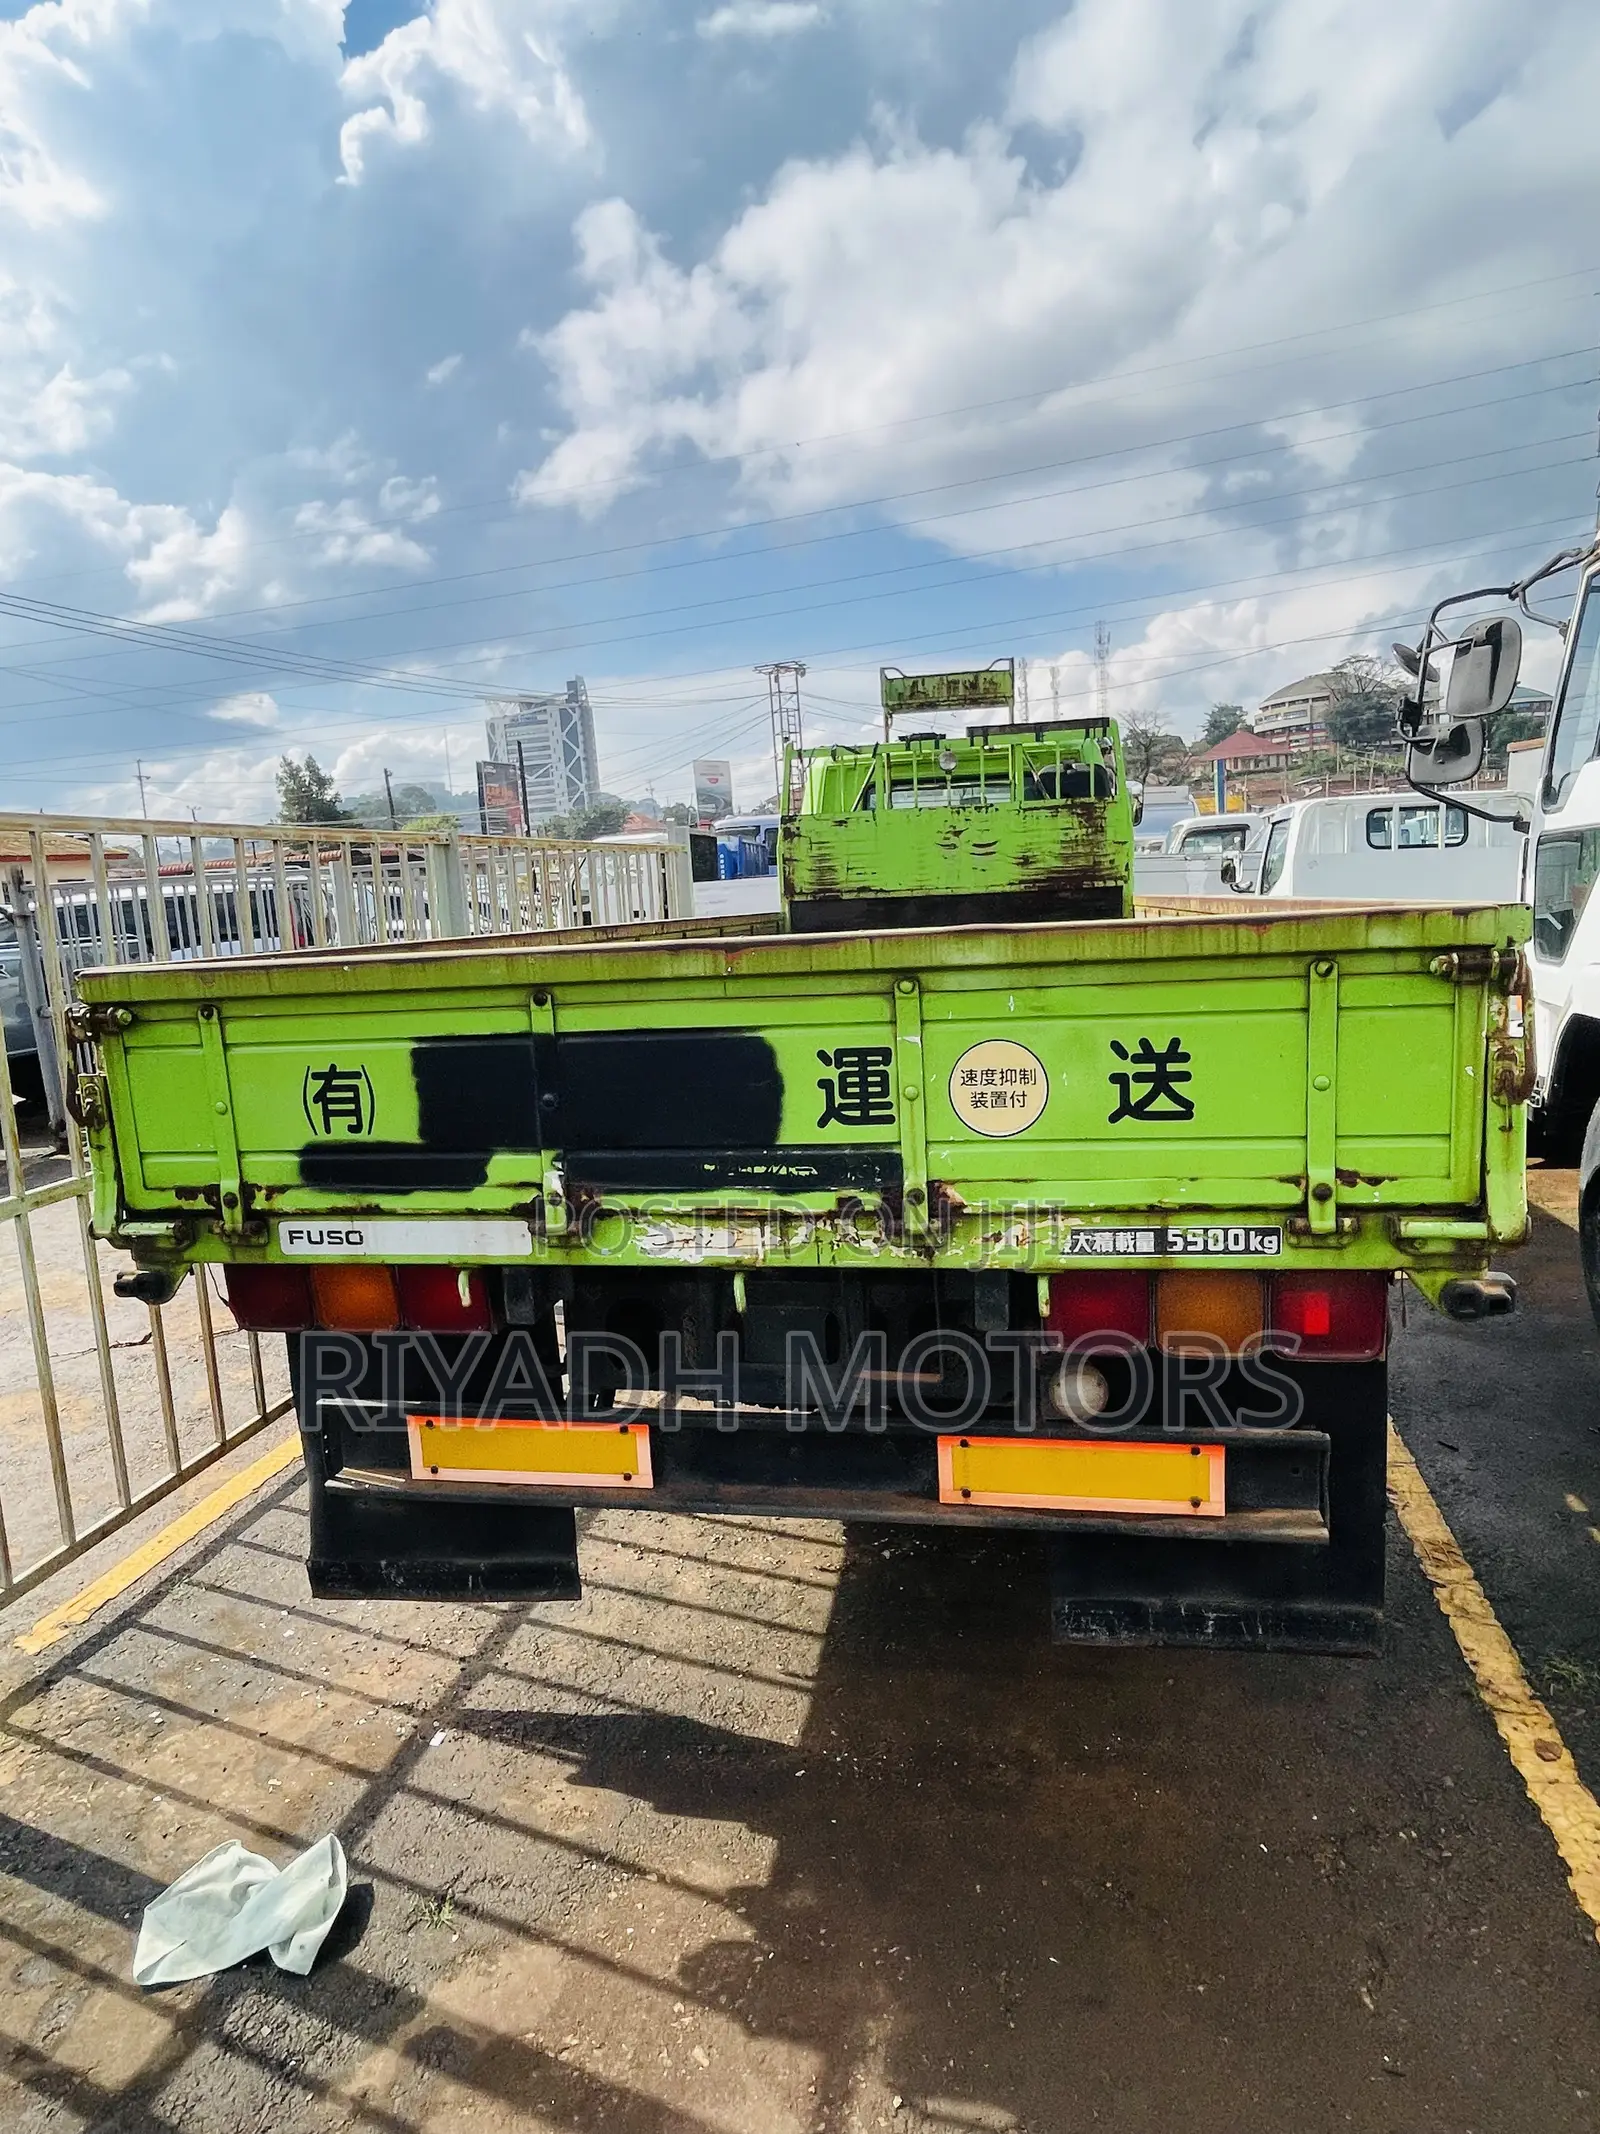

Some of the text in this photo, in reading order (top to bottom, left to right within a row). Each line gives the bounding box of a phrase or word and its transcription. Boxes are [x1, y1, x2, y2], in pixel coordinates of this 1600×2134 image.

[816, 1046, 896, 1129] 運
[1108, 1036, 1195, 1125] 送
[960, 1067, 1037, 1087] 速度抑制
[970, 1090, 1028, 1109] 装置付
[287, 1229, 365, 1246] FUSO
